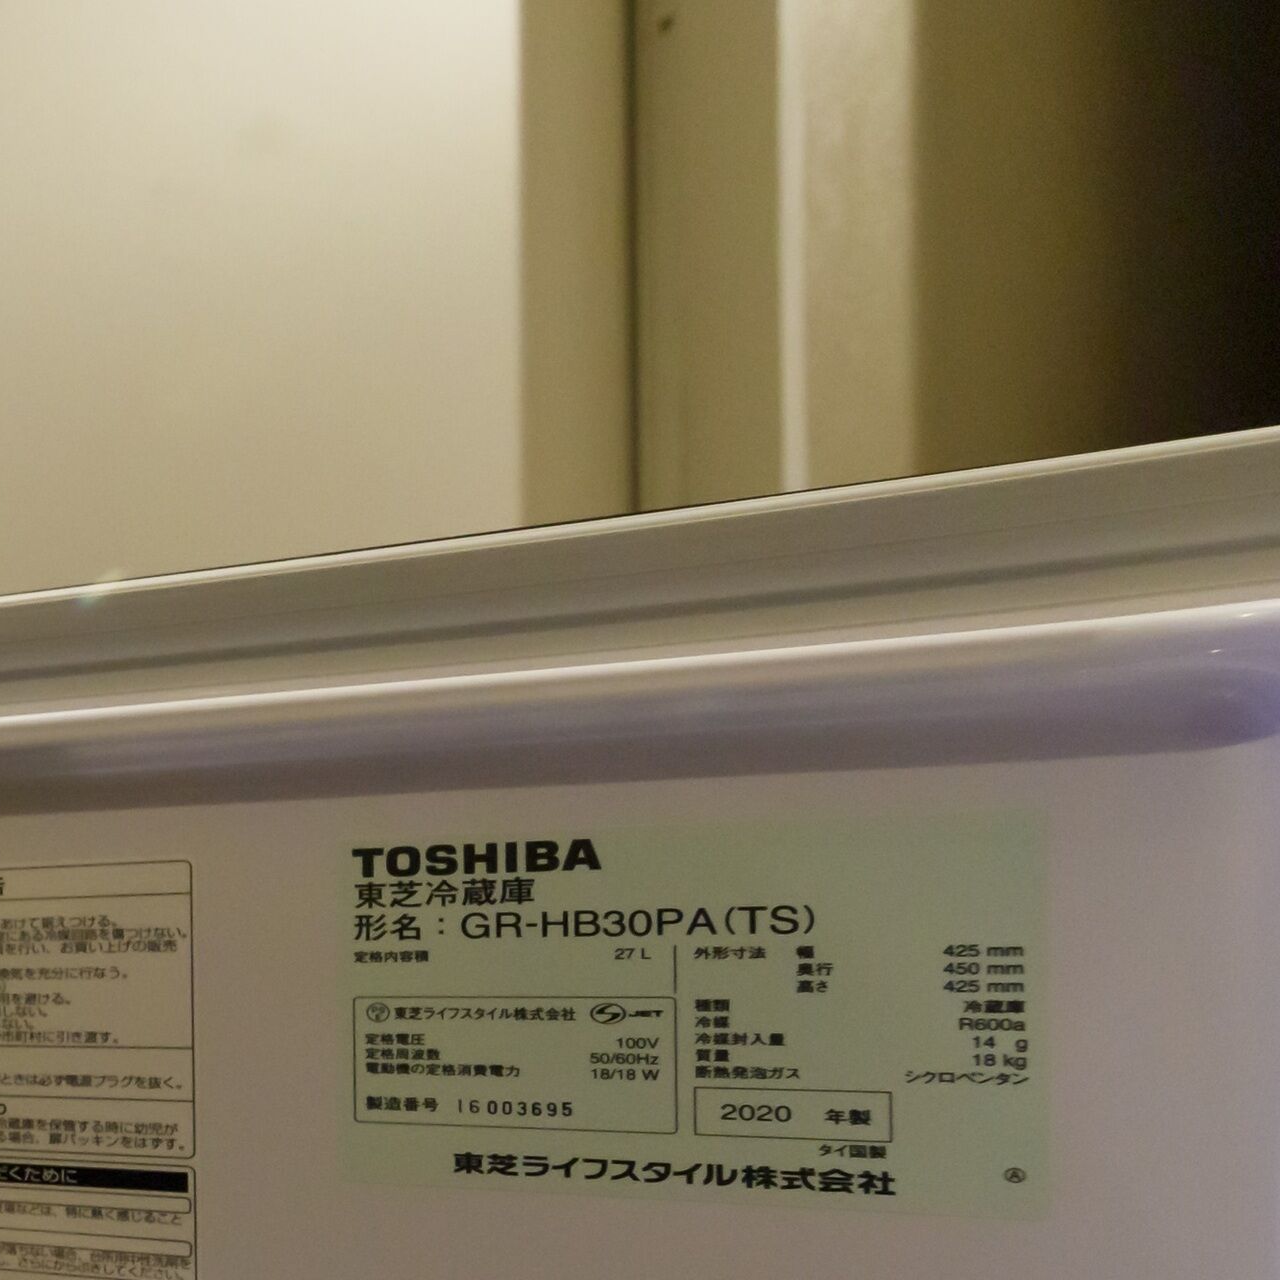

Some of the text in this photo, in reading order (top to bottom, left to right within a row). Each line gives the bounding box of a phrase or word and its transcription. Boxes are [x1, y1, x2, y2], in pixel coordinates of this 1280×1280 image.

[352, 838, 602, 878] TOSHIBA
[354, 876, 536, 909] 東芝冷蔵庫
[354, 948, 651, 963] 定格内容積 27 L
[694, 946, 766, 960] 外形寸法
[943, 944, 980, 957] 425
[986, 946, 1024, 958] mm
[797, 962, 1024, 976] 奥行 450 mm
[797, 980, 1024, 993] 高さ 425 mm
[394, 1006, 577, 1021] 東芝ライフスタイル株式会社
[695, 999, 1026, 1013] 種類 冷蔵庫
[695, 1016, 1025, 1031] 冷媒 R600a
[365, 1033, 659, 1049] 定格電圧 100V
[695, 1033, 1028, 1053] 冷媒封入量 14 g
[366, 1048, 659, 1066] 定格周波数 50/60Hz
[695, 1049, 1028, 1070] 質量 18 kg
[366, 1063, 659, 1081] 電動機の定格消費電力 18/18 W
[695, 1065, 800, 1080] 断熱発泡ガス
[366, 1096, 439, 1112] 製造番号
[720, 1104, 872, 1126] 2020 年製
[818, 1144, 887, 1159] タイ国製
[453, 1152, 897, 1195] 東芝ライフスタイル株式会社
